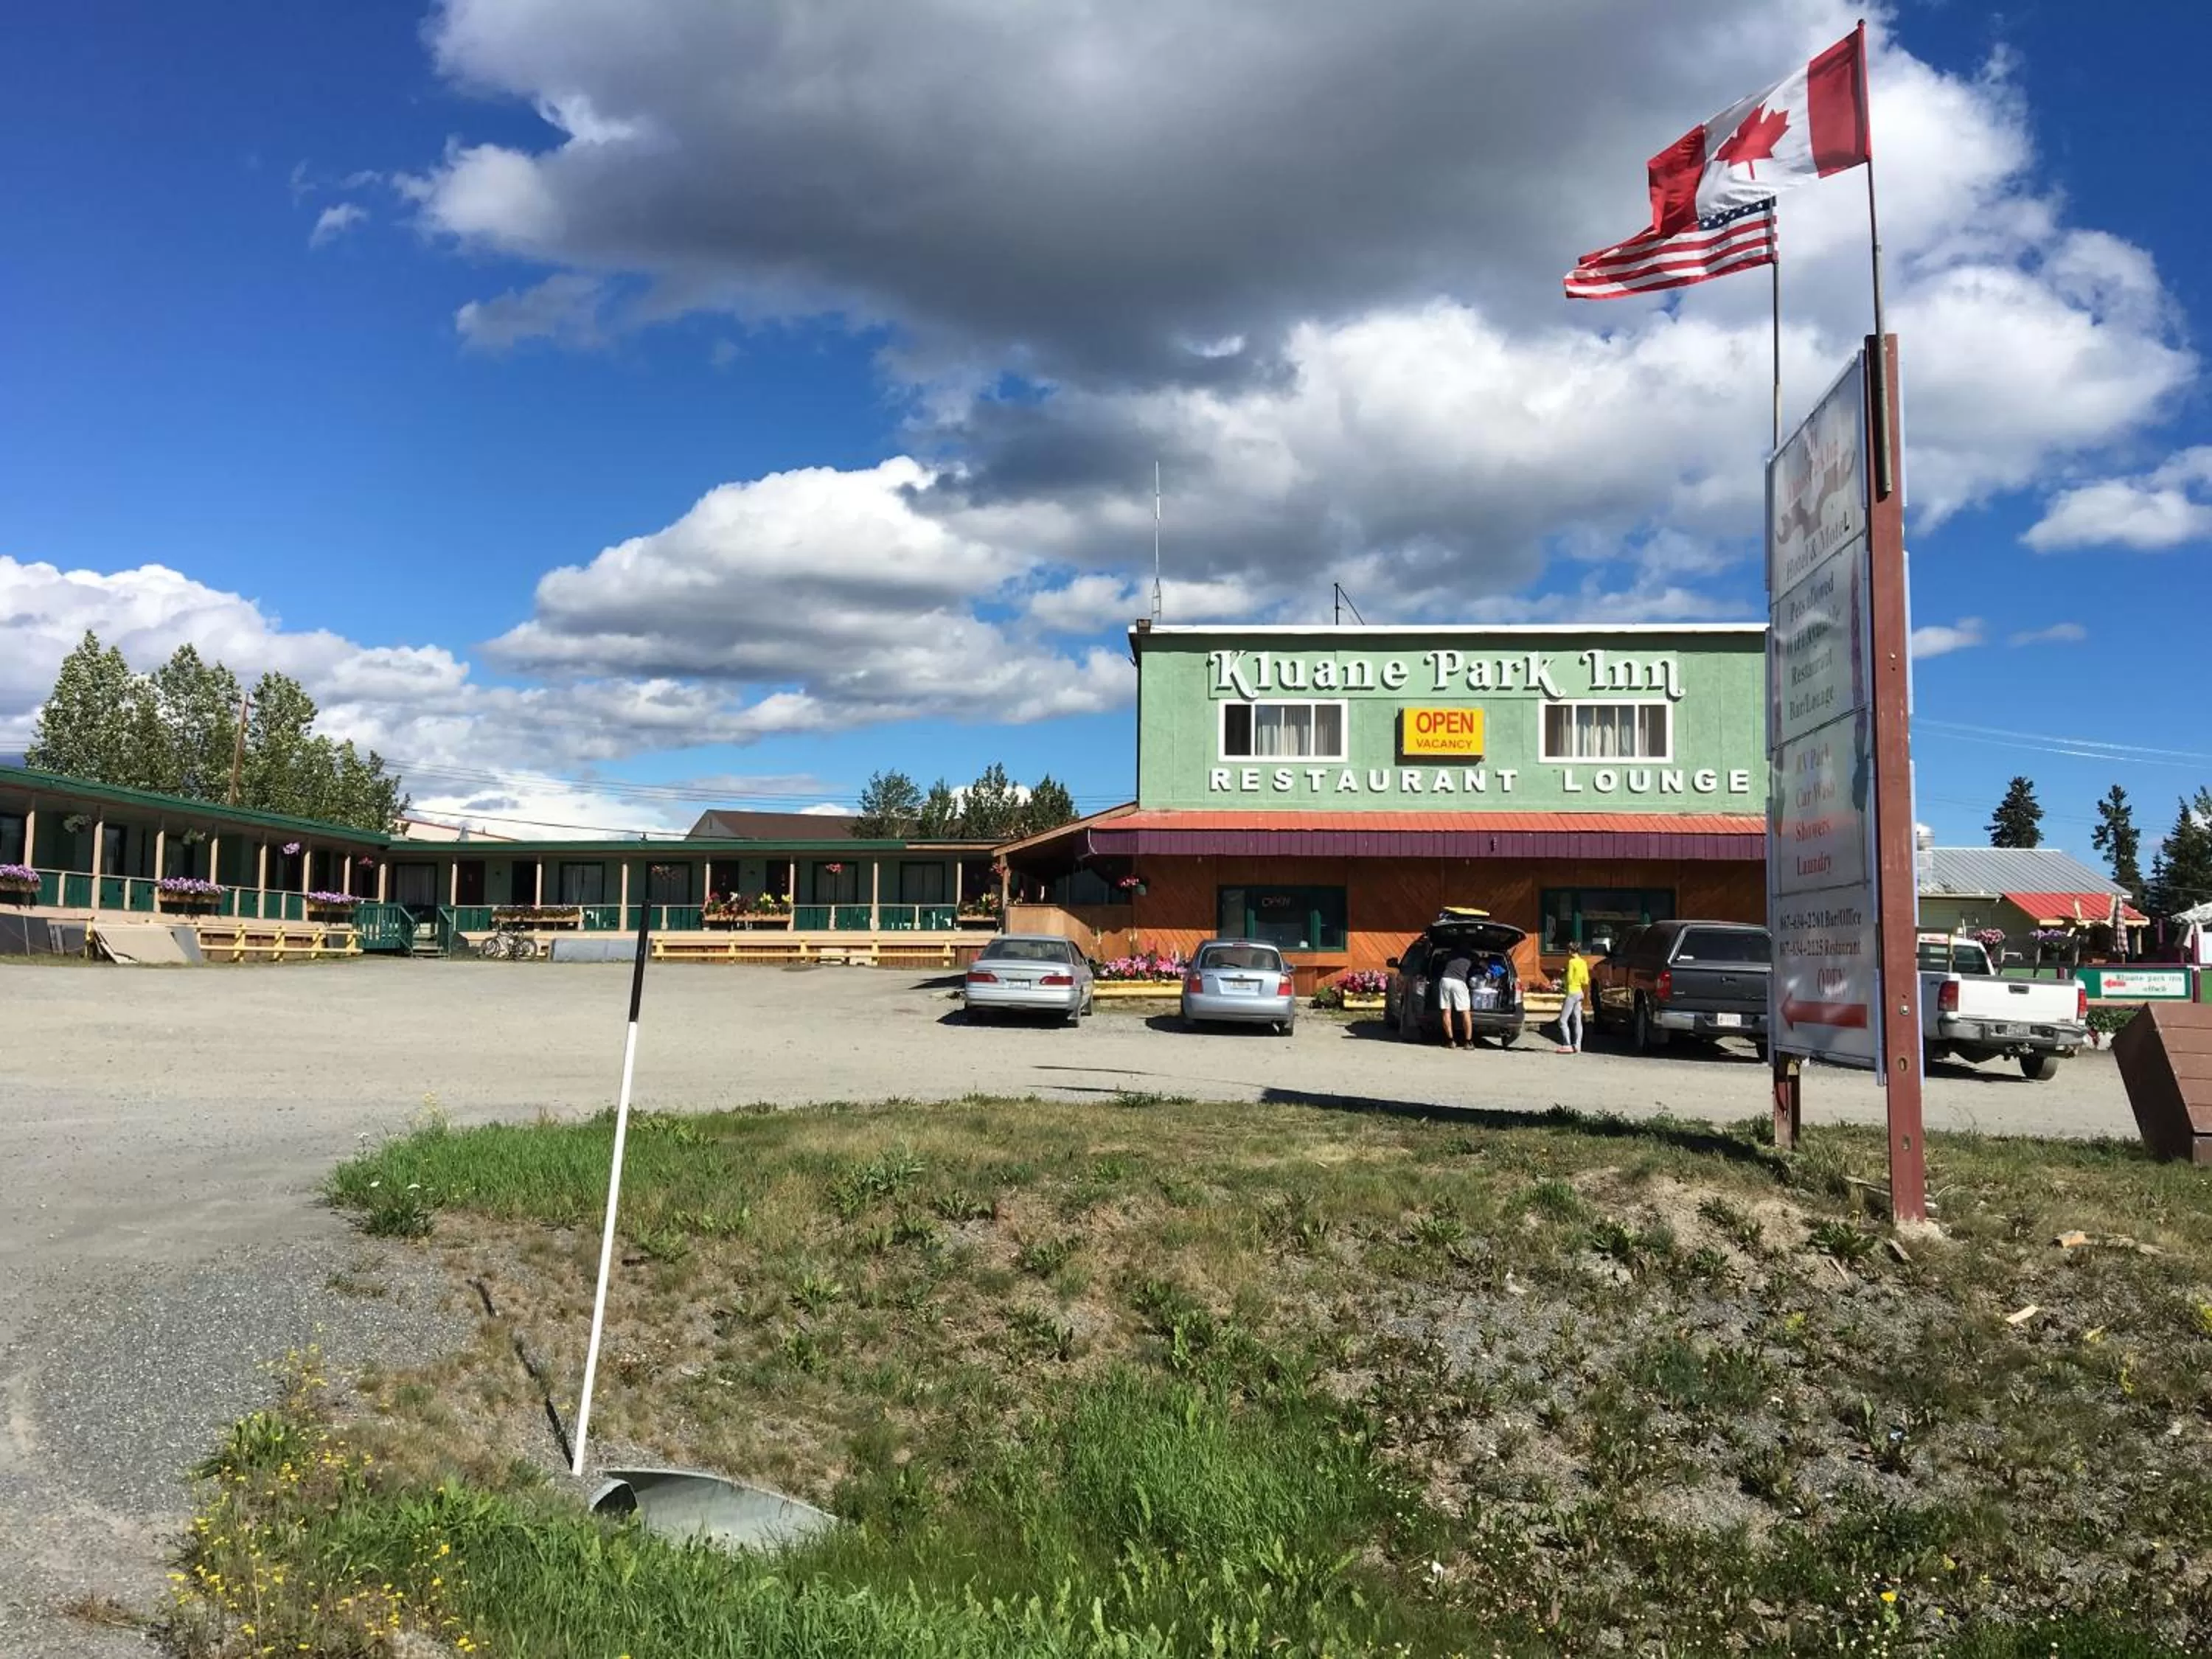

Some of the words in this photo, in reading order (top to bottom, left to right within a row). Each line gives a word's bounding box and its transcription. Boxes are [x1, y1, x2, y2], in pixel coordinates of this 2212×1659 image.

[1208, 650, 1411, 700] Kluane
[1425, 650, 1567, 700] Park
[1579, 650, 1686, 700] Inn
[1416, 712, 1474, 734] OPEN
[1416, 739, 1473, 749] VACANCY
[1209, 768, 1518, 792] RESTAURANT
[1562, 768, 1750, 793] LOUNGE
[1797, 852, 1832, 877] Laundry
